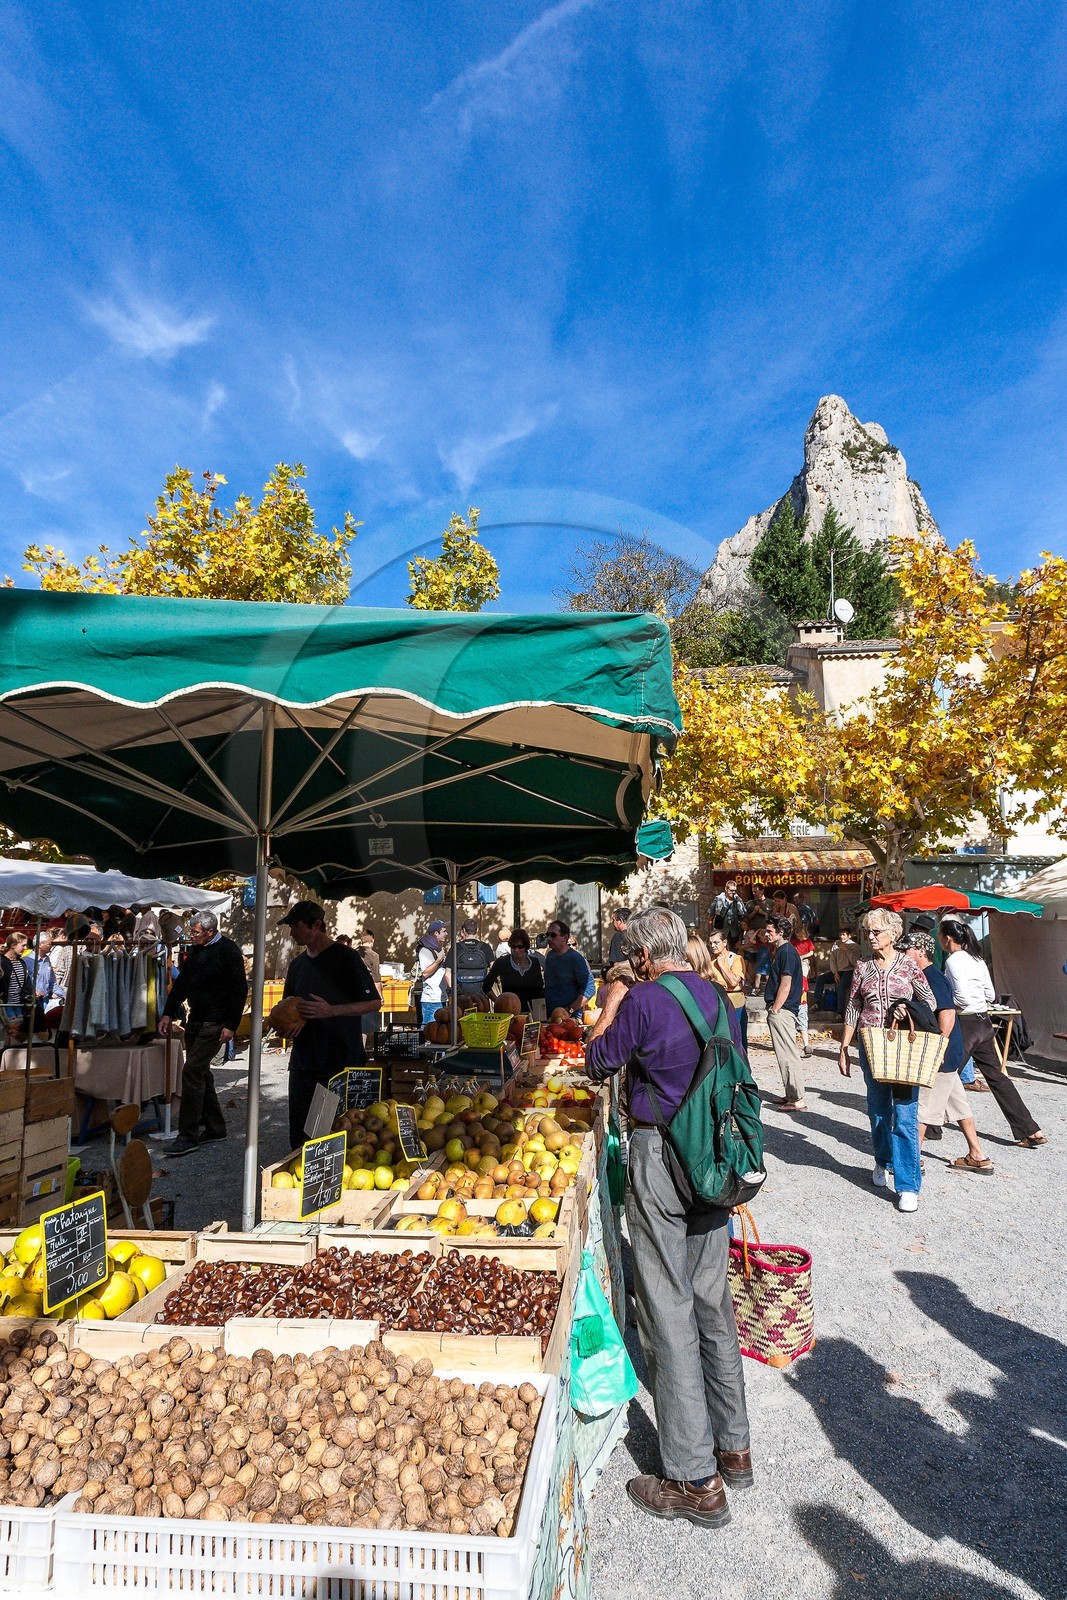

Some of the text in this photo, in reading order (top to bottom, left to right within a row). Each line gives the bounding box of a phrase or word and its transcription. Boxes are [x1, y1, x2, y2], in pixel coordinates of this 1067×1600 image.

[735, 873, 863, 886] BOULANGERIE D'ORPIER
[65, 1261, 105, 1294] 3,00 €
